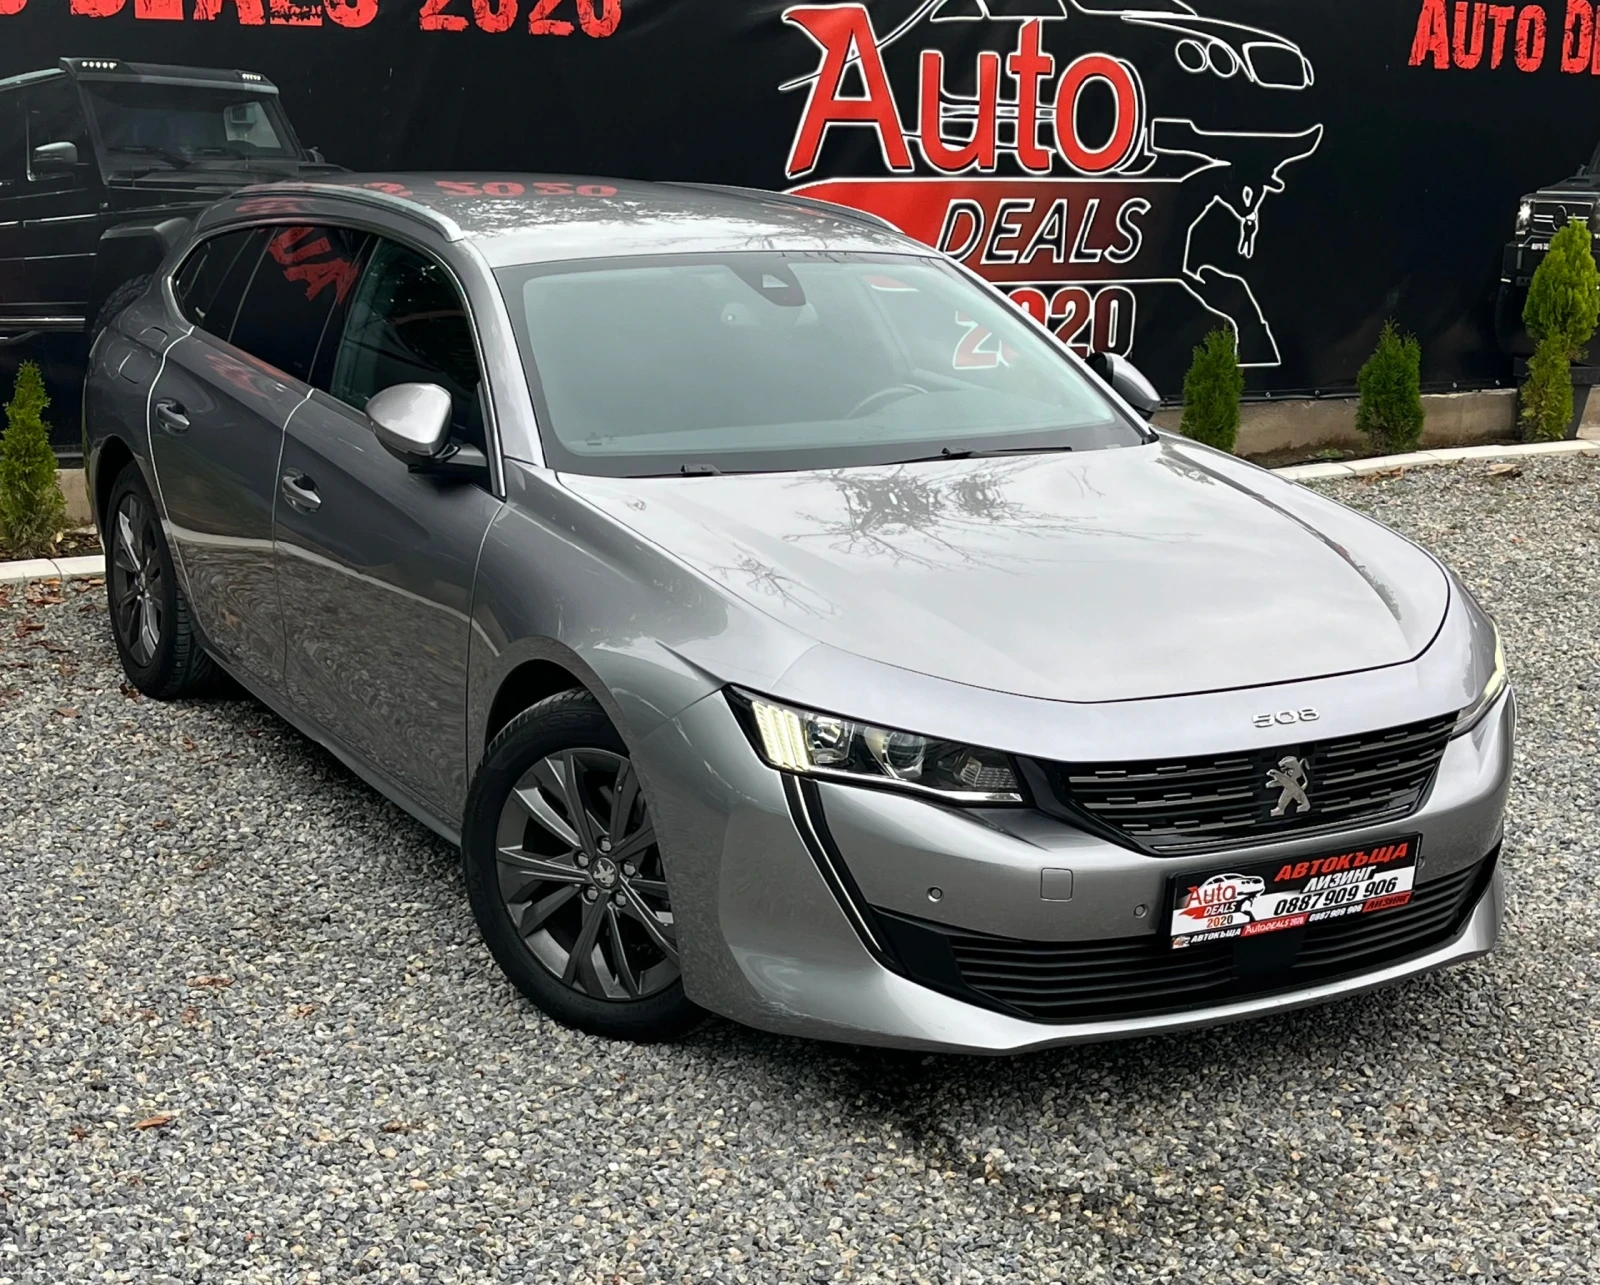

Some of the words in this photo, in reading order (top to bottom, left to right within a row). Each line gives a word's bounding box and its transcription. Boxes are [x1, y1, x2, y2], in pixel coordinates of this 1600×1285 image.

[1408, 0, 1547, 72] AUTO
[1561, 0, 1600, 75] D
[781, 3, 1138, 177] Auto
[935, 197, 1152, 265] DEALS
[1252, 707, 1320, 728] 508
[1274, 842, 1409, 882] АВТОКЪЩА
[1302, 865, 1377, 893] ЛИЗИНГ
[1323, 884, 1360, 907] 909
[1363, 876, 1399, 898] 906
[1186, 883, 1238, 908] Auto
[1203, 902, 1237, 917] DEALS
[1206, 914, 1234, 929] 2020
[1190, 928, 1242, 944] АВТОКЪЩА
